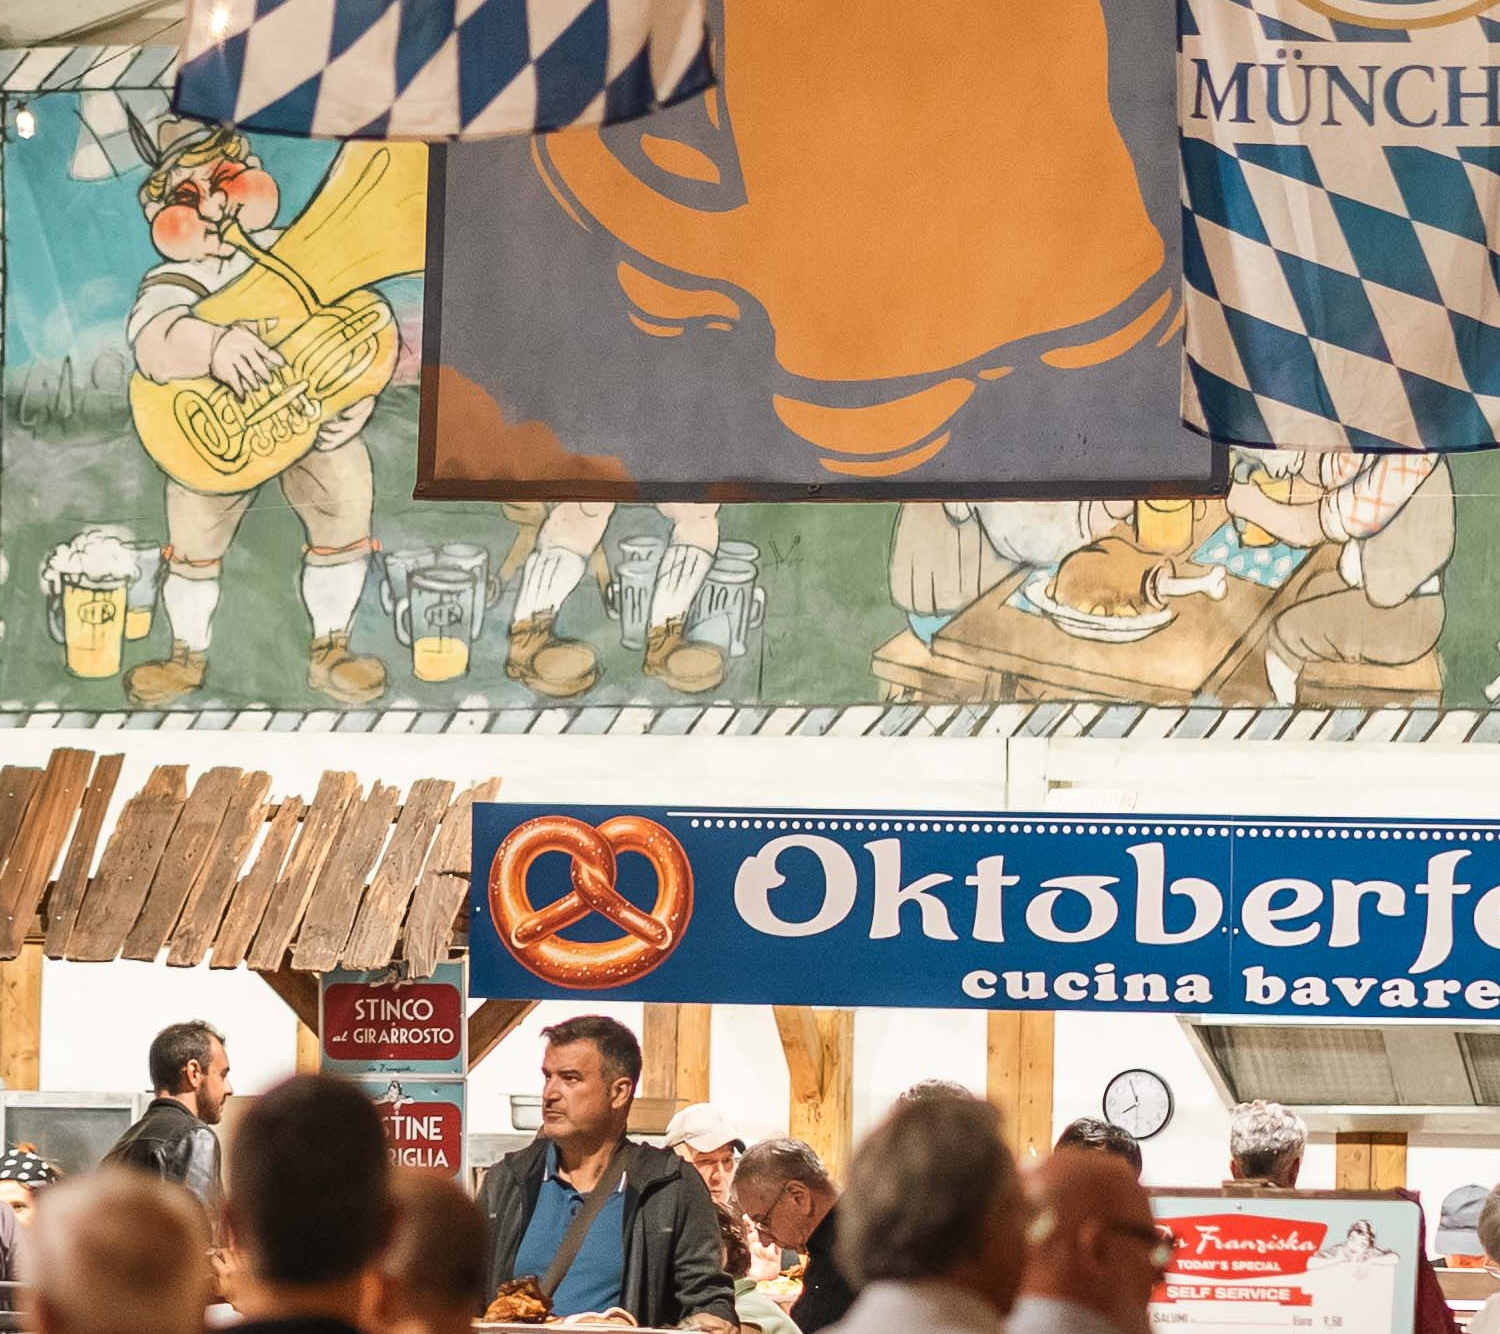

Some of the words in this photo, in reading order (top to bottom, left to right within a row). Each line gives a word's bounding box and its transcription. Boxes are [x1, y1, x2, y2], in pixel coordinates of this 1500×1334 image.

[961, 957, 1212, 1007] cucina
[354, 998, 434, 1021] STINCO
[353, 1027, 455, 1044] GIRARROSTO
[1195, 1224, 1319, 1255] Franziska
[1176, 1259, 1229, 1271] TODAY'S
[1231, 1260, 1283, 1272] SPECIAL
[1166, 1286, 1212, 1299] SELF
[1214, 1286, 1291, 1301] SERVICE
